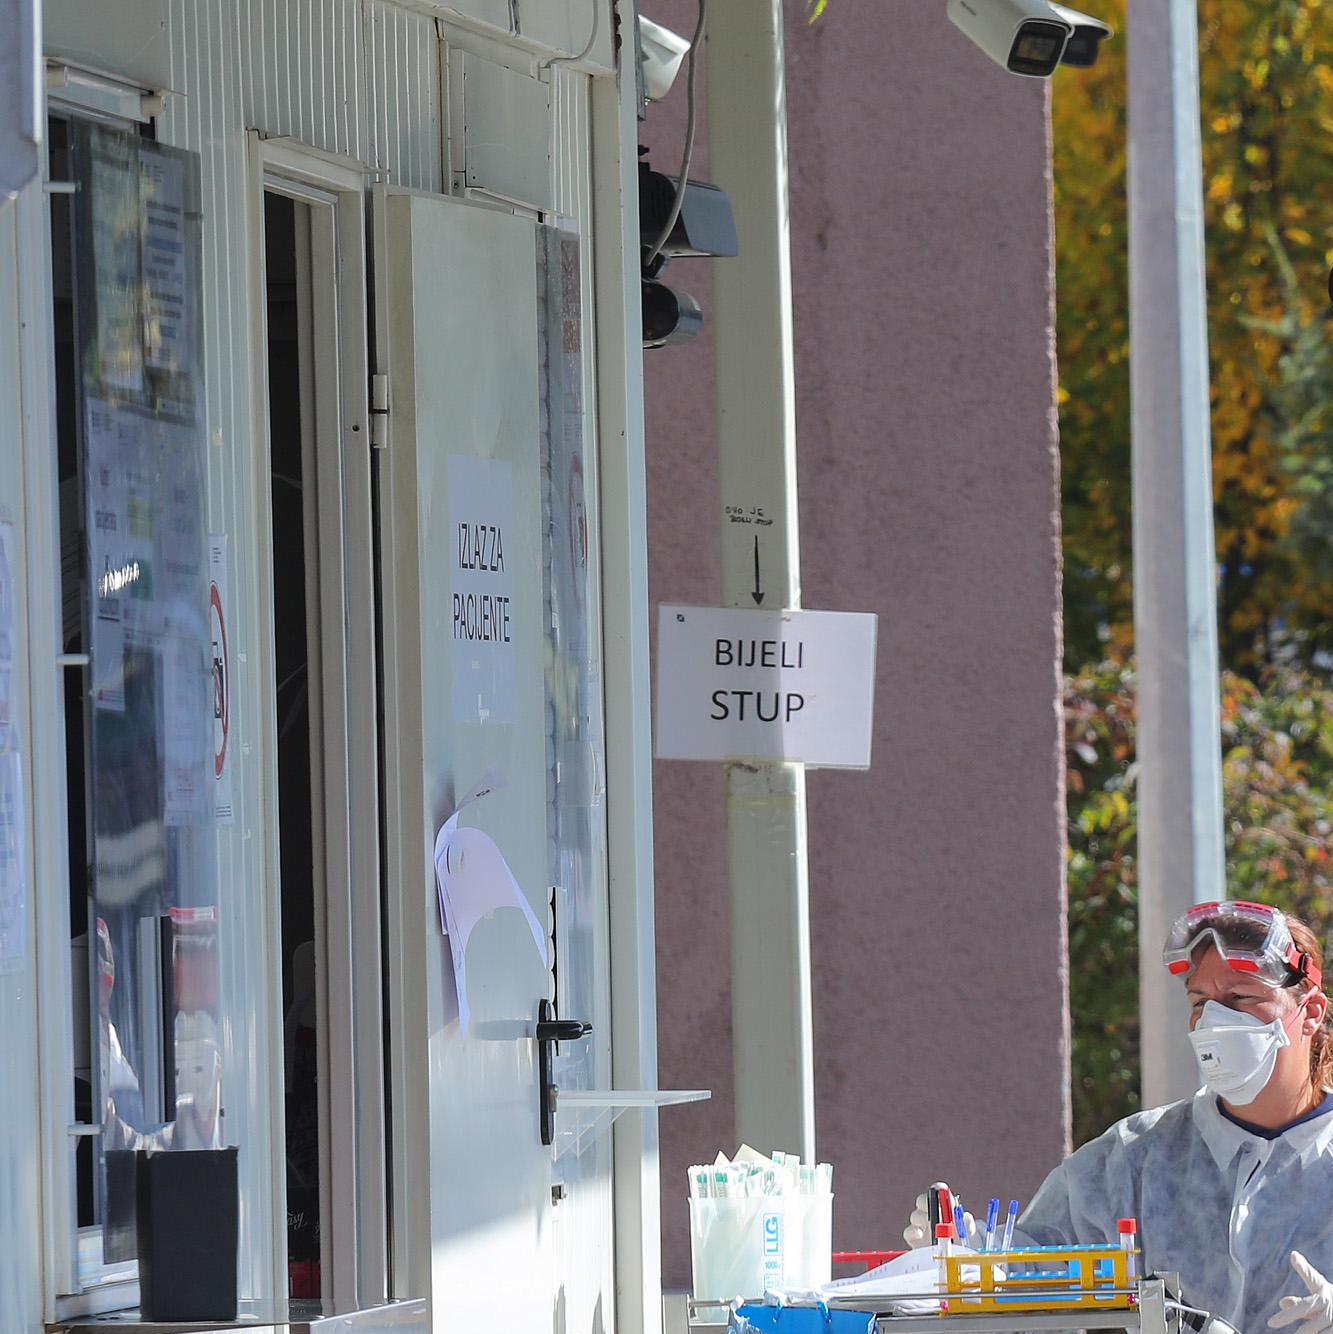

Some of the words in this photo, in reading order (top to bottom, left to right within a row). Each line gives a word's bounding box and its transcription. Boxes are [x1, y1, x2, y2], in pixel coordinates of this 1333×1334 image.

[458, 522, 488, 571] IZLAZ
[489, 526, 505, 573] ZA
[453, 592, 511, 643] PACIJENTE
[715, 638, 803, 669] BIJELI
[710, 690, 805, 723] STUP
[765, 1216, 779, 1253] LLG
